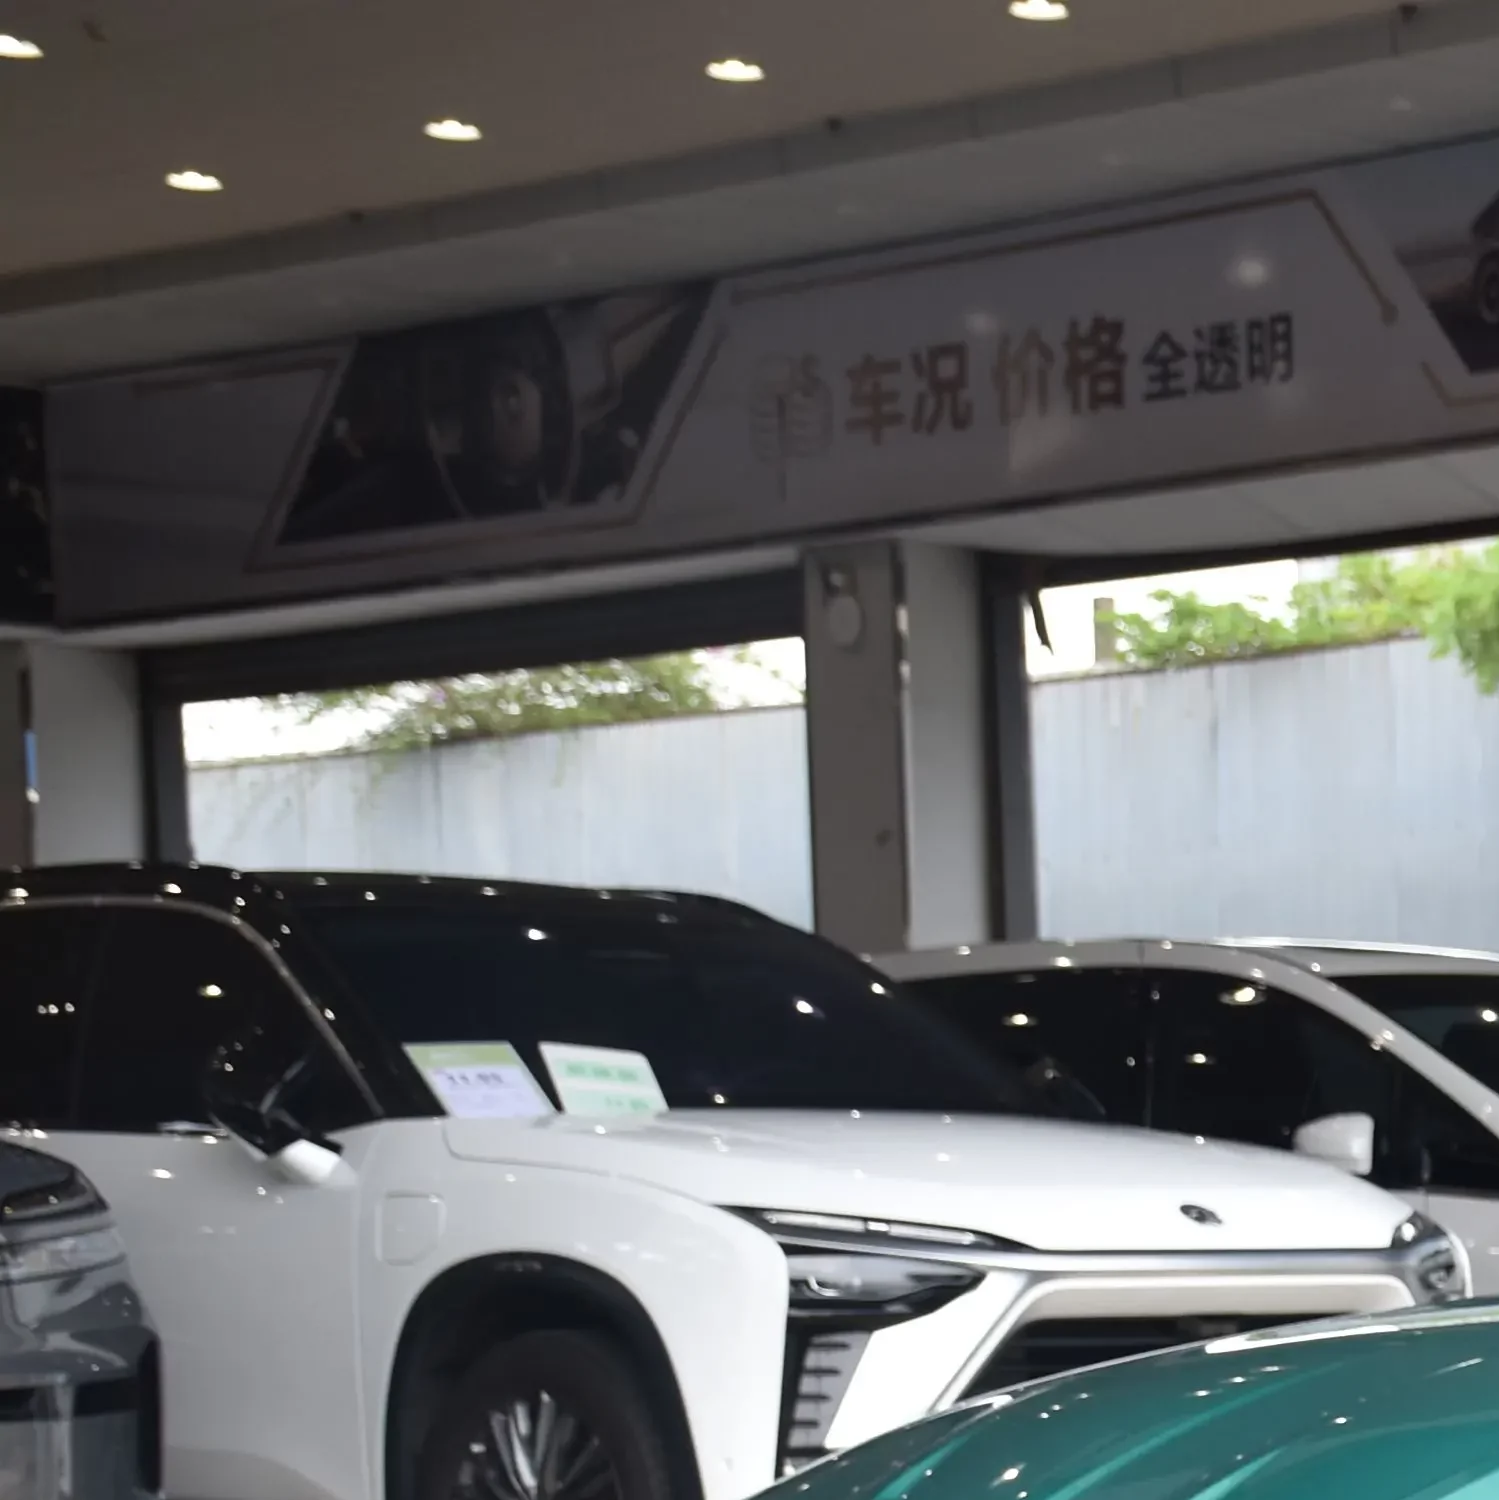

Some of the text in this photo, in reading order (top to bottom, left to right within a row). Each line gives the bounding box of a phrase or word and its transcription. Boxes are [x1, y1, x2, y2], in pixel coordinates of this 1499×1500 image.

[845, 311, 1296, 447] 车况 价格 全透明
